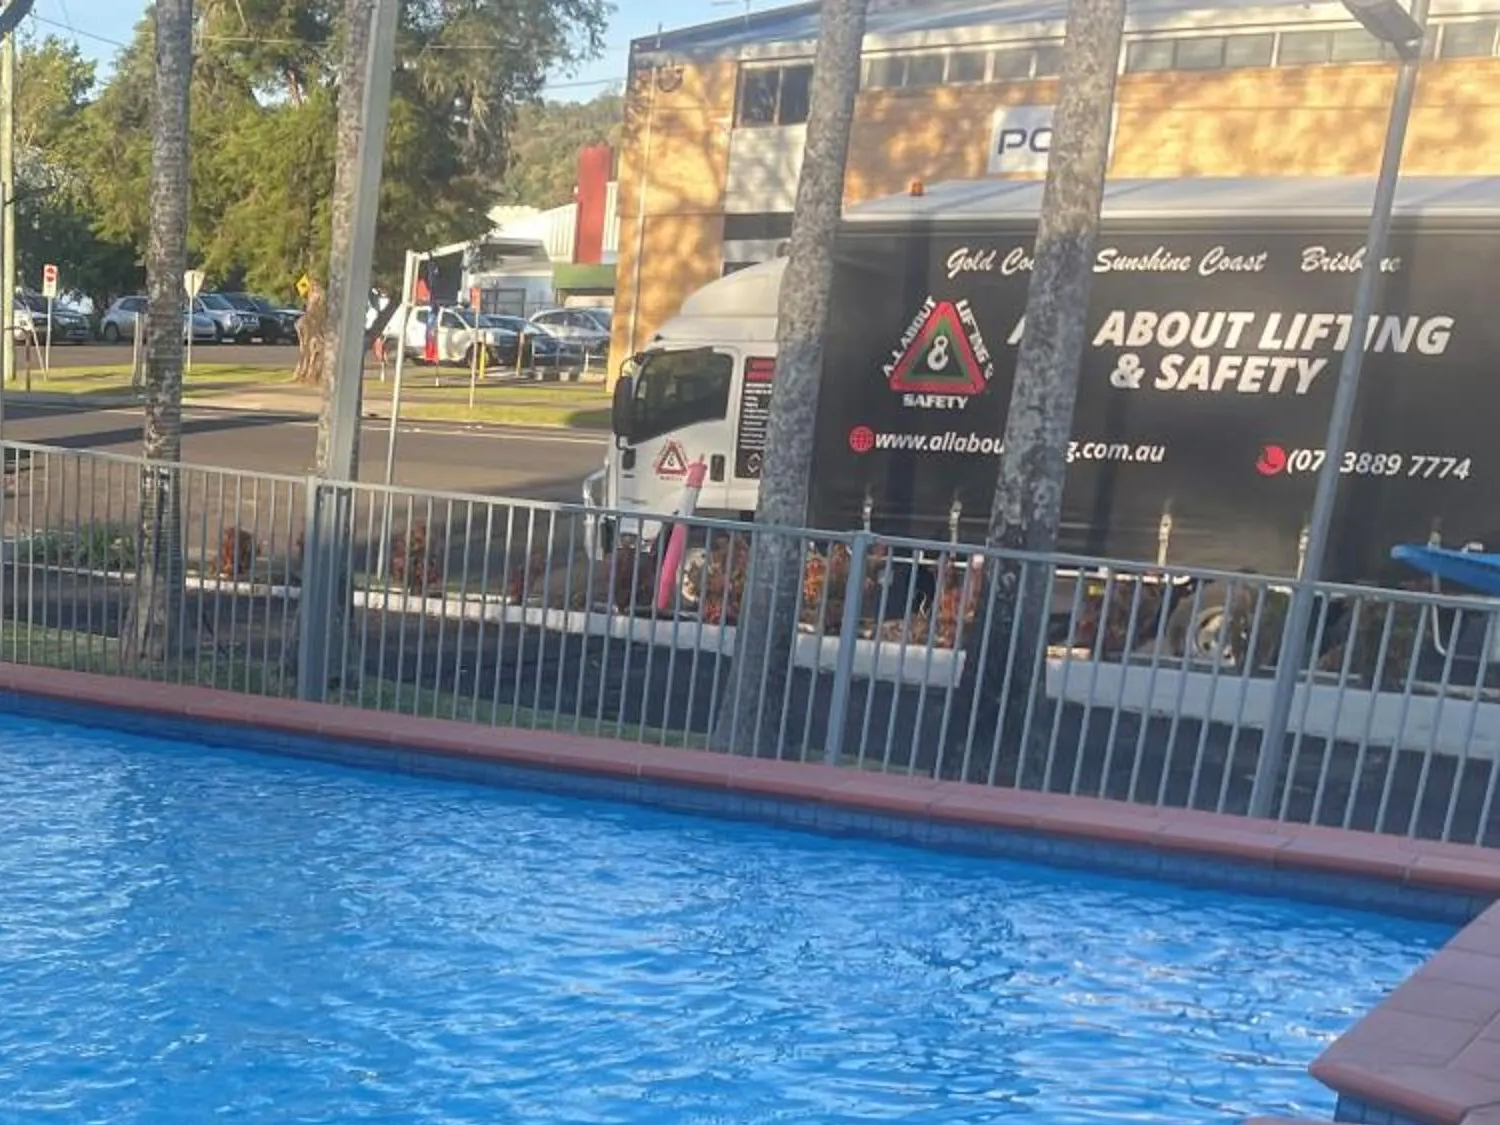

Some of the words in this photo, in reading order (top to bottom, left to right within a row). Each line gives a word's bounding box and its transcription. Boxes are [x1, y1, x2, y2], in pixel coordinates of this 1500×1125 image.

[947, 247, 997, 279] Gold
[1092, 245, 1191, 273] Sunshine
[1198, 245, 1268, 276] Coast
[1300, 245, 1402, 273] Brisbne
[1092, 310, 1255, 349] ABOUT
[1258, 311, 1455, 355] LIFTING
[1110, 353, 1146, 390] &
[1154, 353, 1328, 395] SAFETY
[903, 393, 969, 410] SAFETY
[1287, 449, 1327, 475] (07
[1339, 451, 1403, 477] 3889
[1407, 454, 1472, 481] 7774
